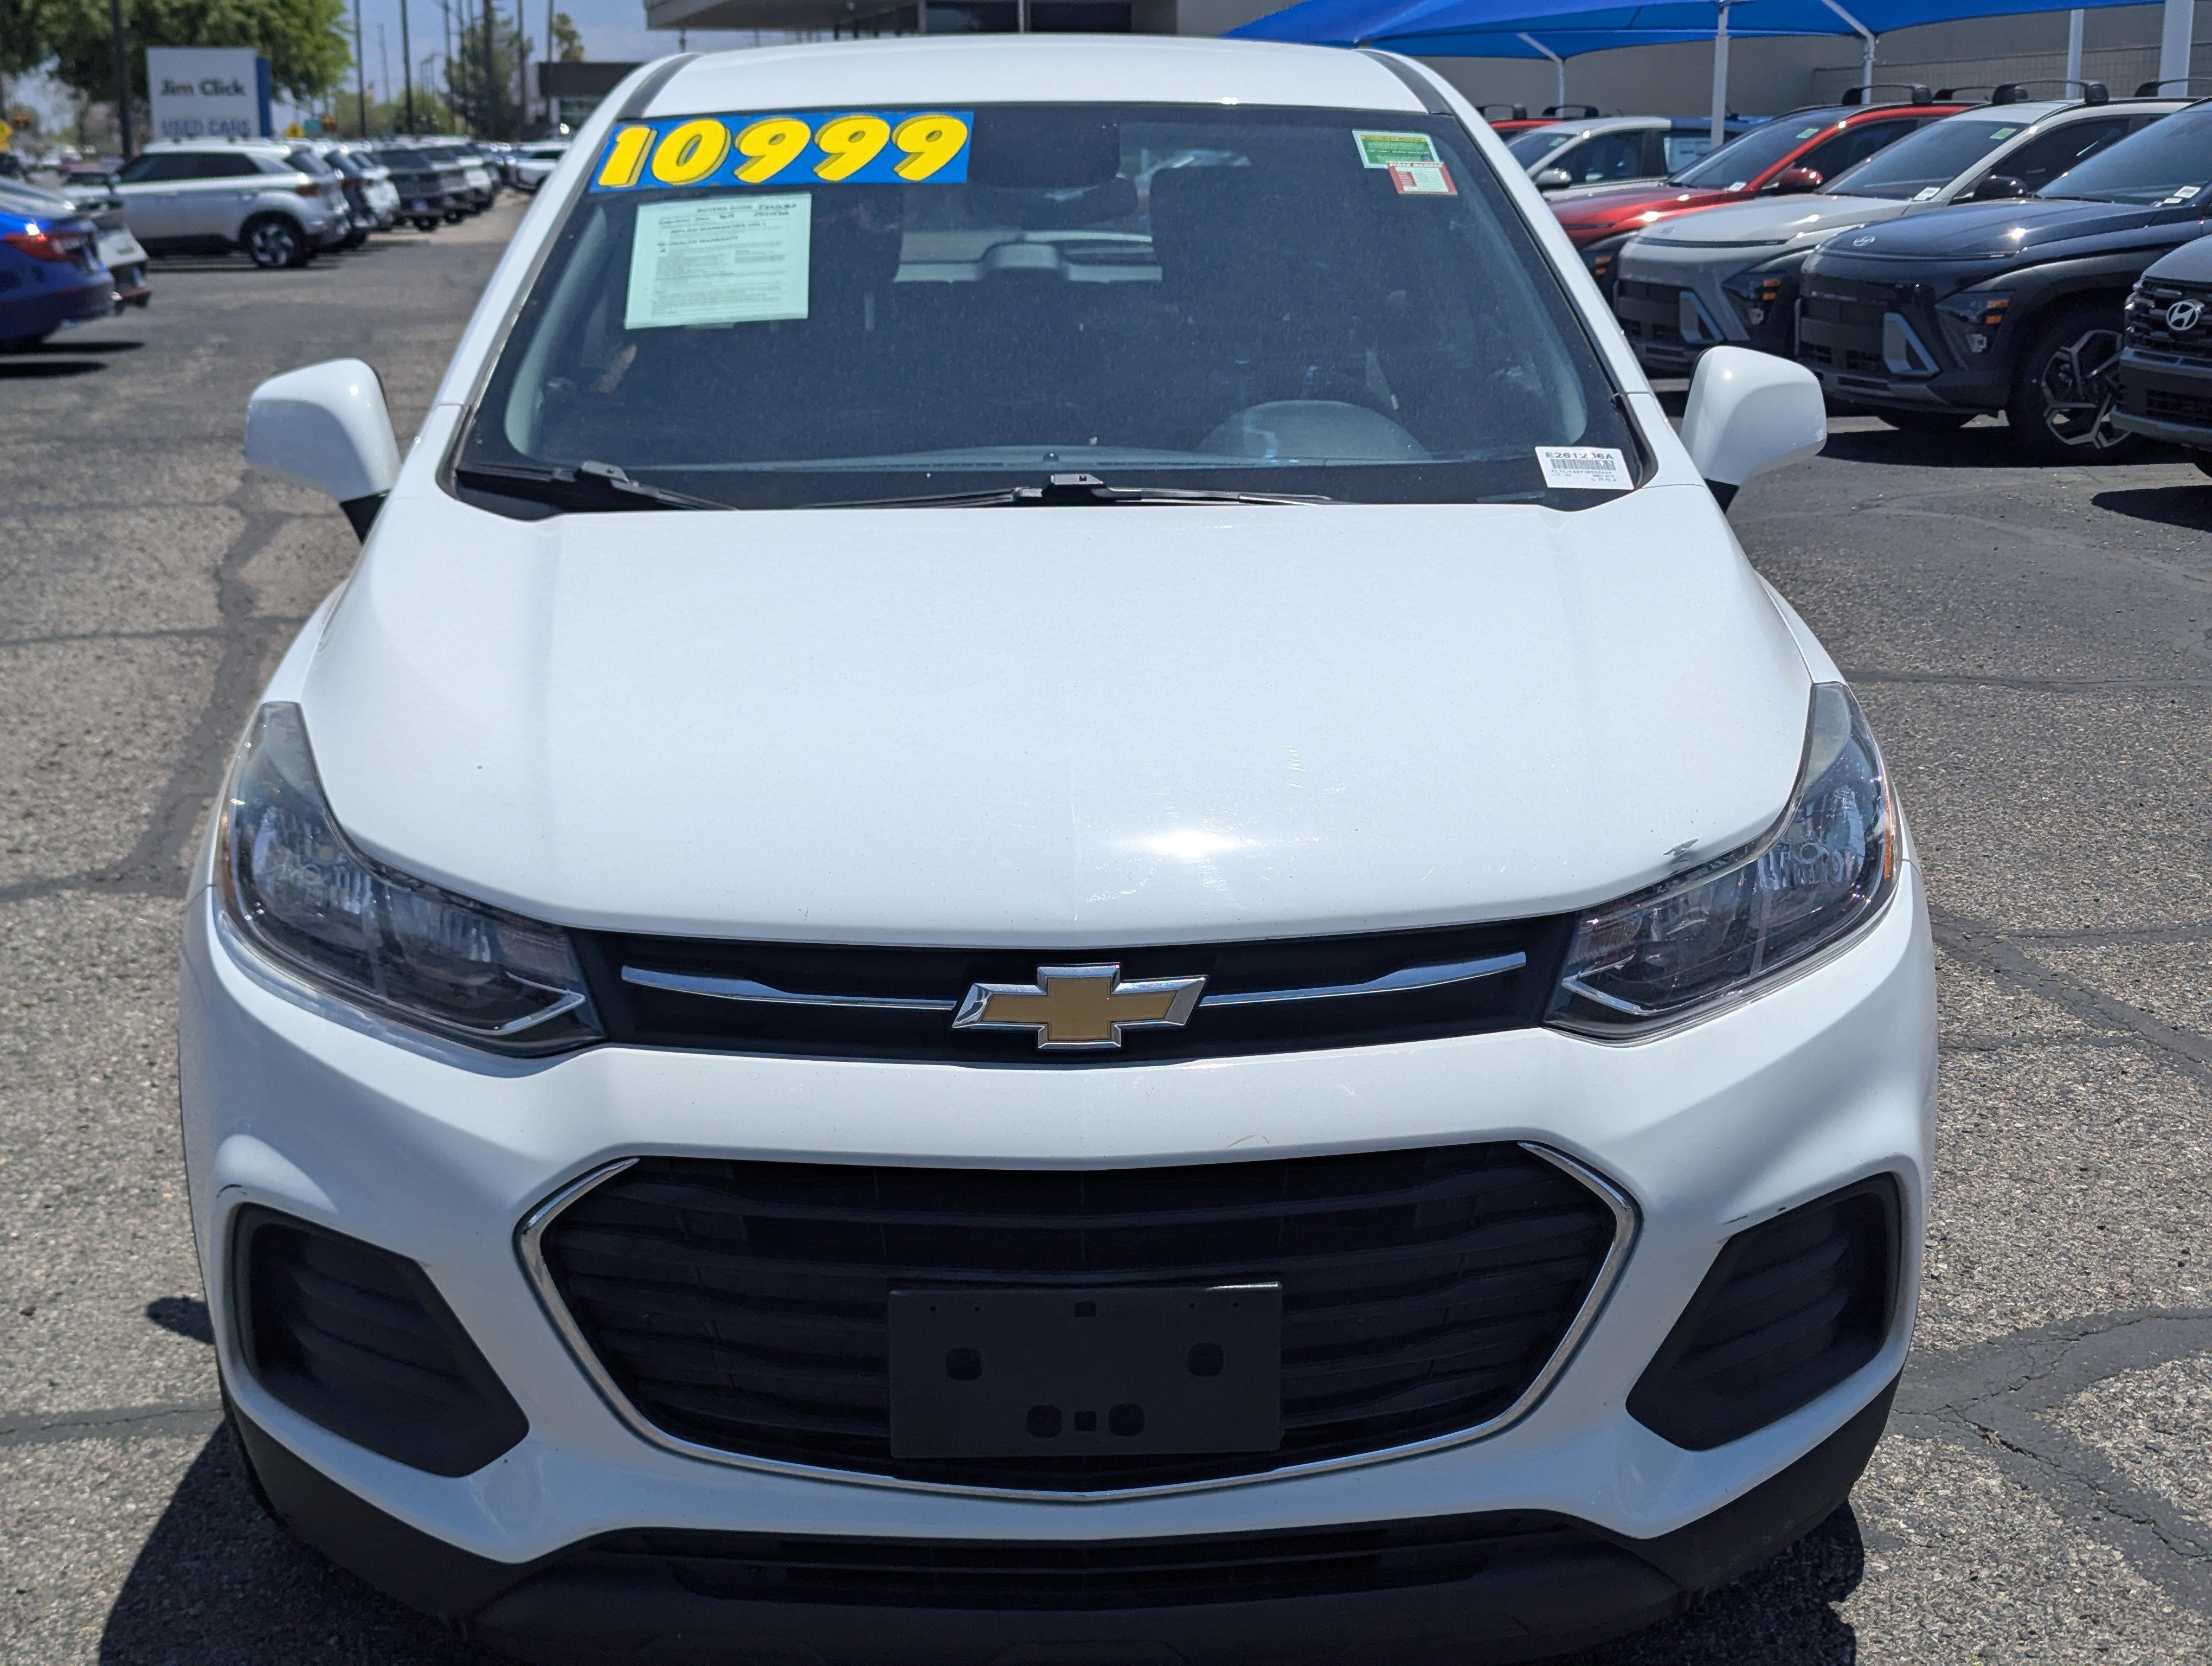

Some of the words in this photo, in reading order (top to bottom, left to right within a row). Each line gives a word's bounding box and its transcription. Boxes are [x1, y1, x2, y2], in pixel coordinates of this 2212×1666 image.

[161, 79, 194, 95] Jim
[198, 78, 247, 96] Click
[162, 118, 204, 137] USED
[208, 118, 250, 137] CARS
[598, 114, 968, 188] 10999
